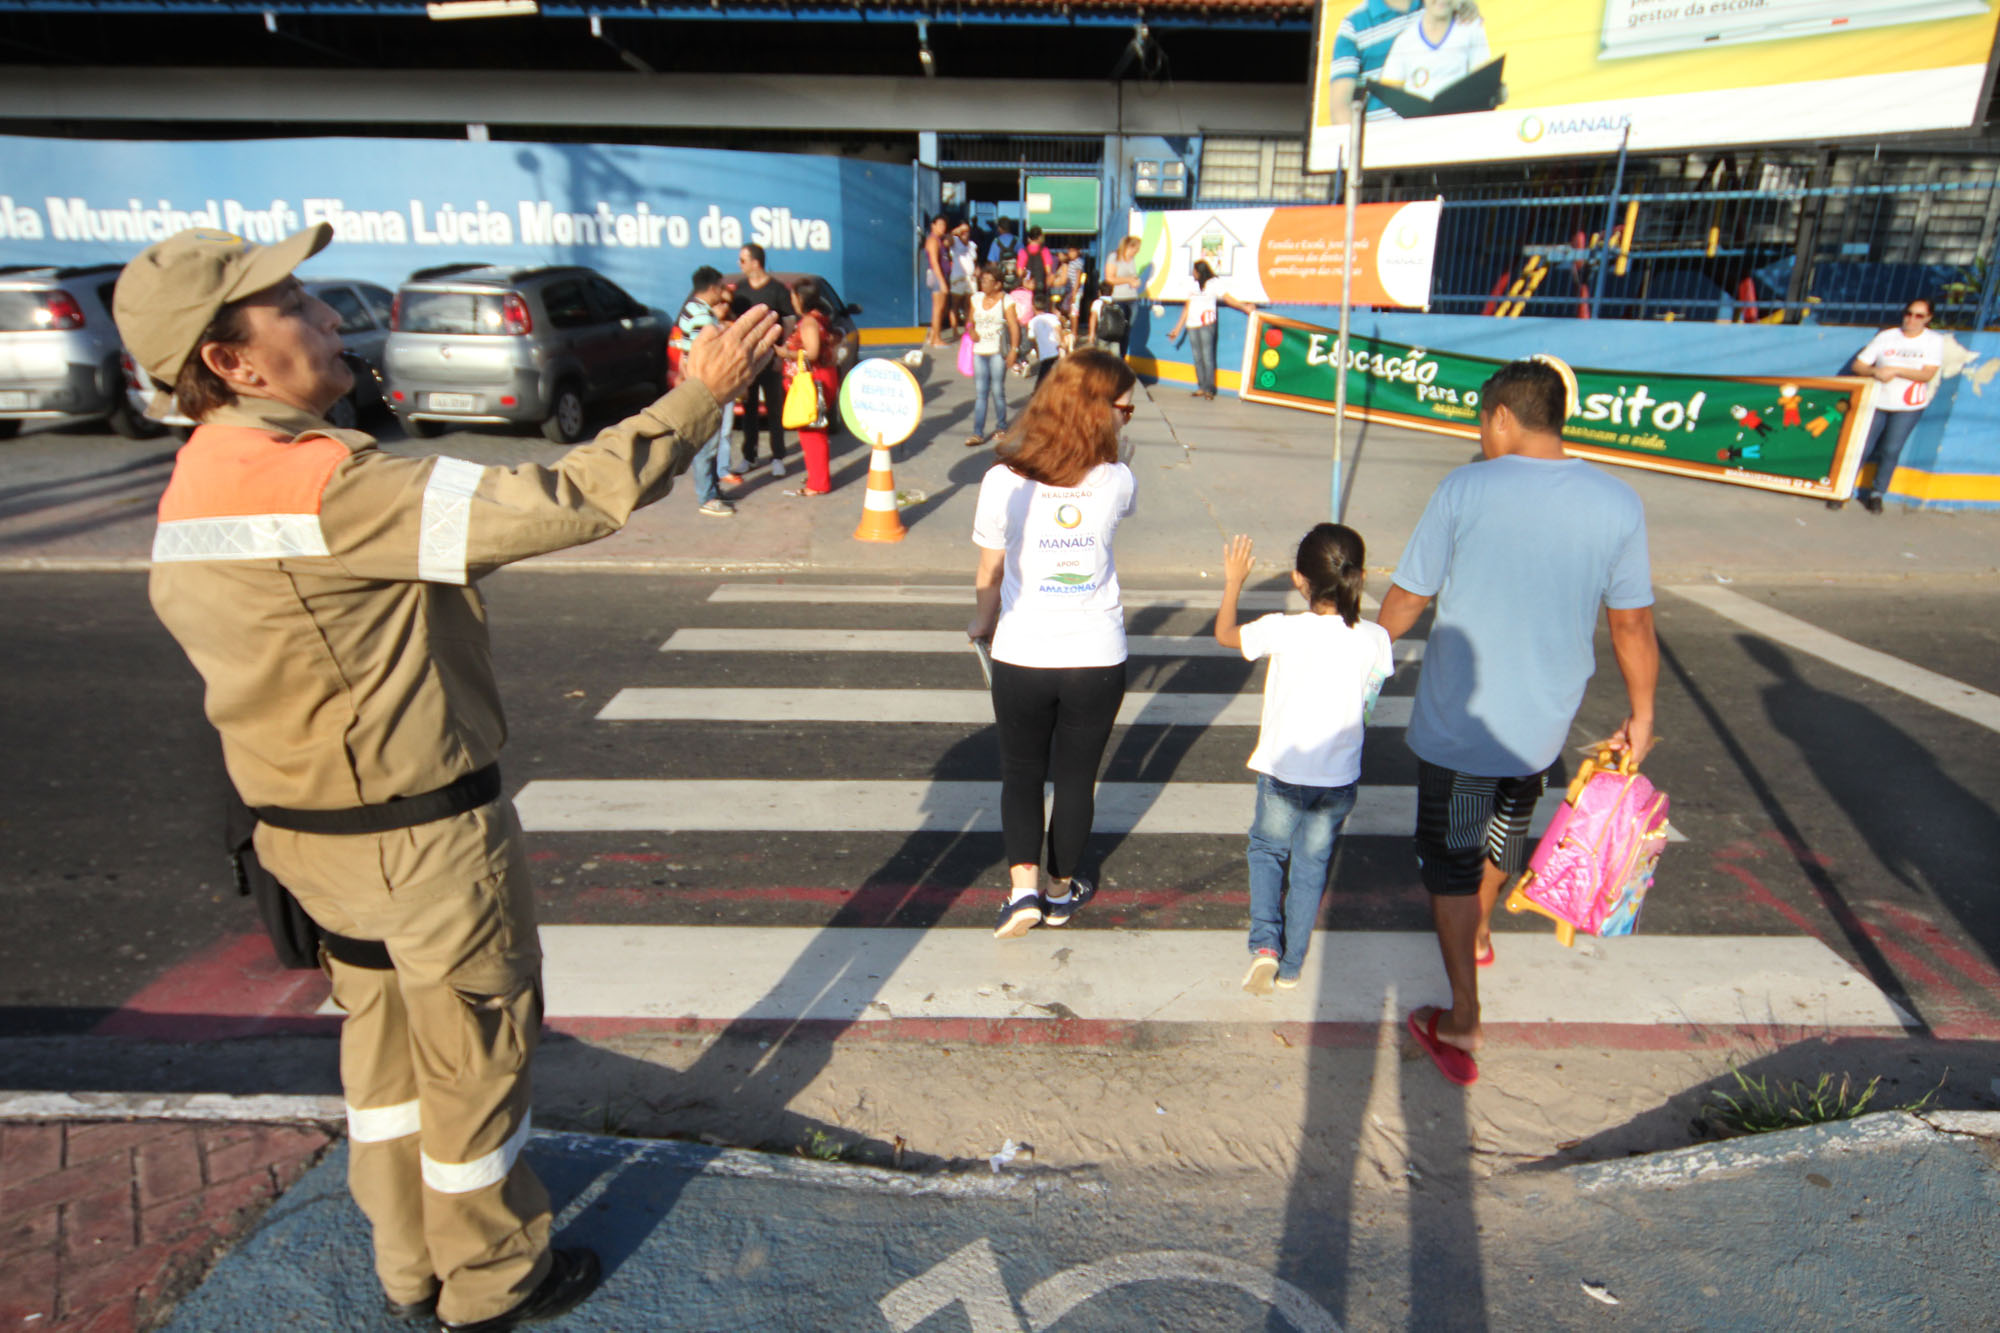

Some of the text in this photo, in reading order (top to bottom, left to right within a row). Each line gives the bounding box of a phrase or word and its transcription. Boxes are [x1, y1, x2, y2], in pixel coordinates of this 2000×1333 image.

[1628, 7, 1679, 27] gestor
[1684, 2, 1704, 17] da
[1547, 112, 1634, 135] MANAUS
[45, 196, 222, 243] Municipal
[410, 200, 513, 246] Lúcia
[518, 200, 690, 247] Monteiro
[699, 204, 743, 248] da
[750, 205, 831, 251] Silva
[1416, 383, 1459, 403] para
[1462, 390, 1479, 407] o
[1573, 384, 1707, 433] sito!
[1041, 490, 1093, 499] REALIZAÇÃO
[1038, 536, 1095, 549] MANAUS
[1056, 560, 1080, 568] APOIO
[1039, 583, 1097, 594] AMAZONAS
